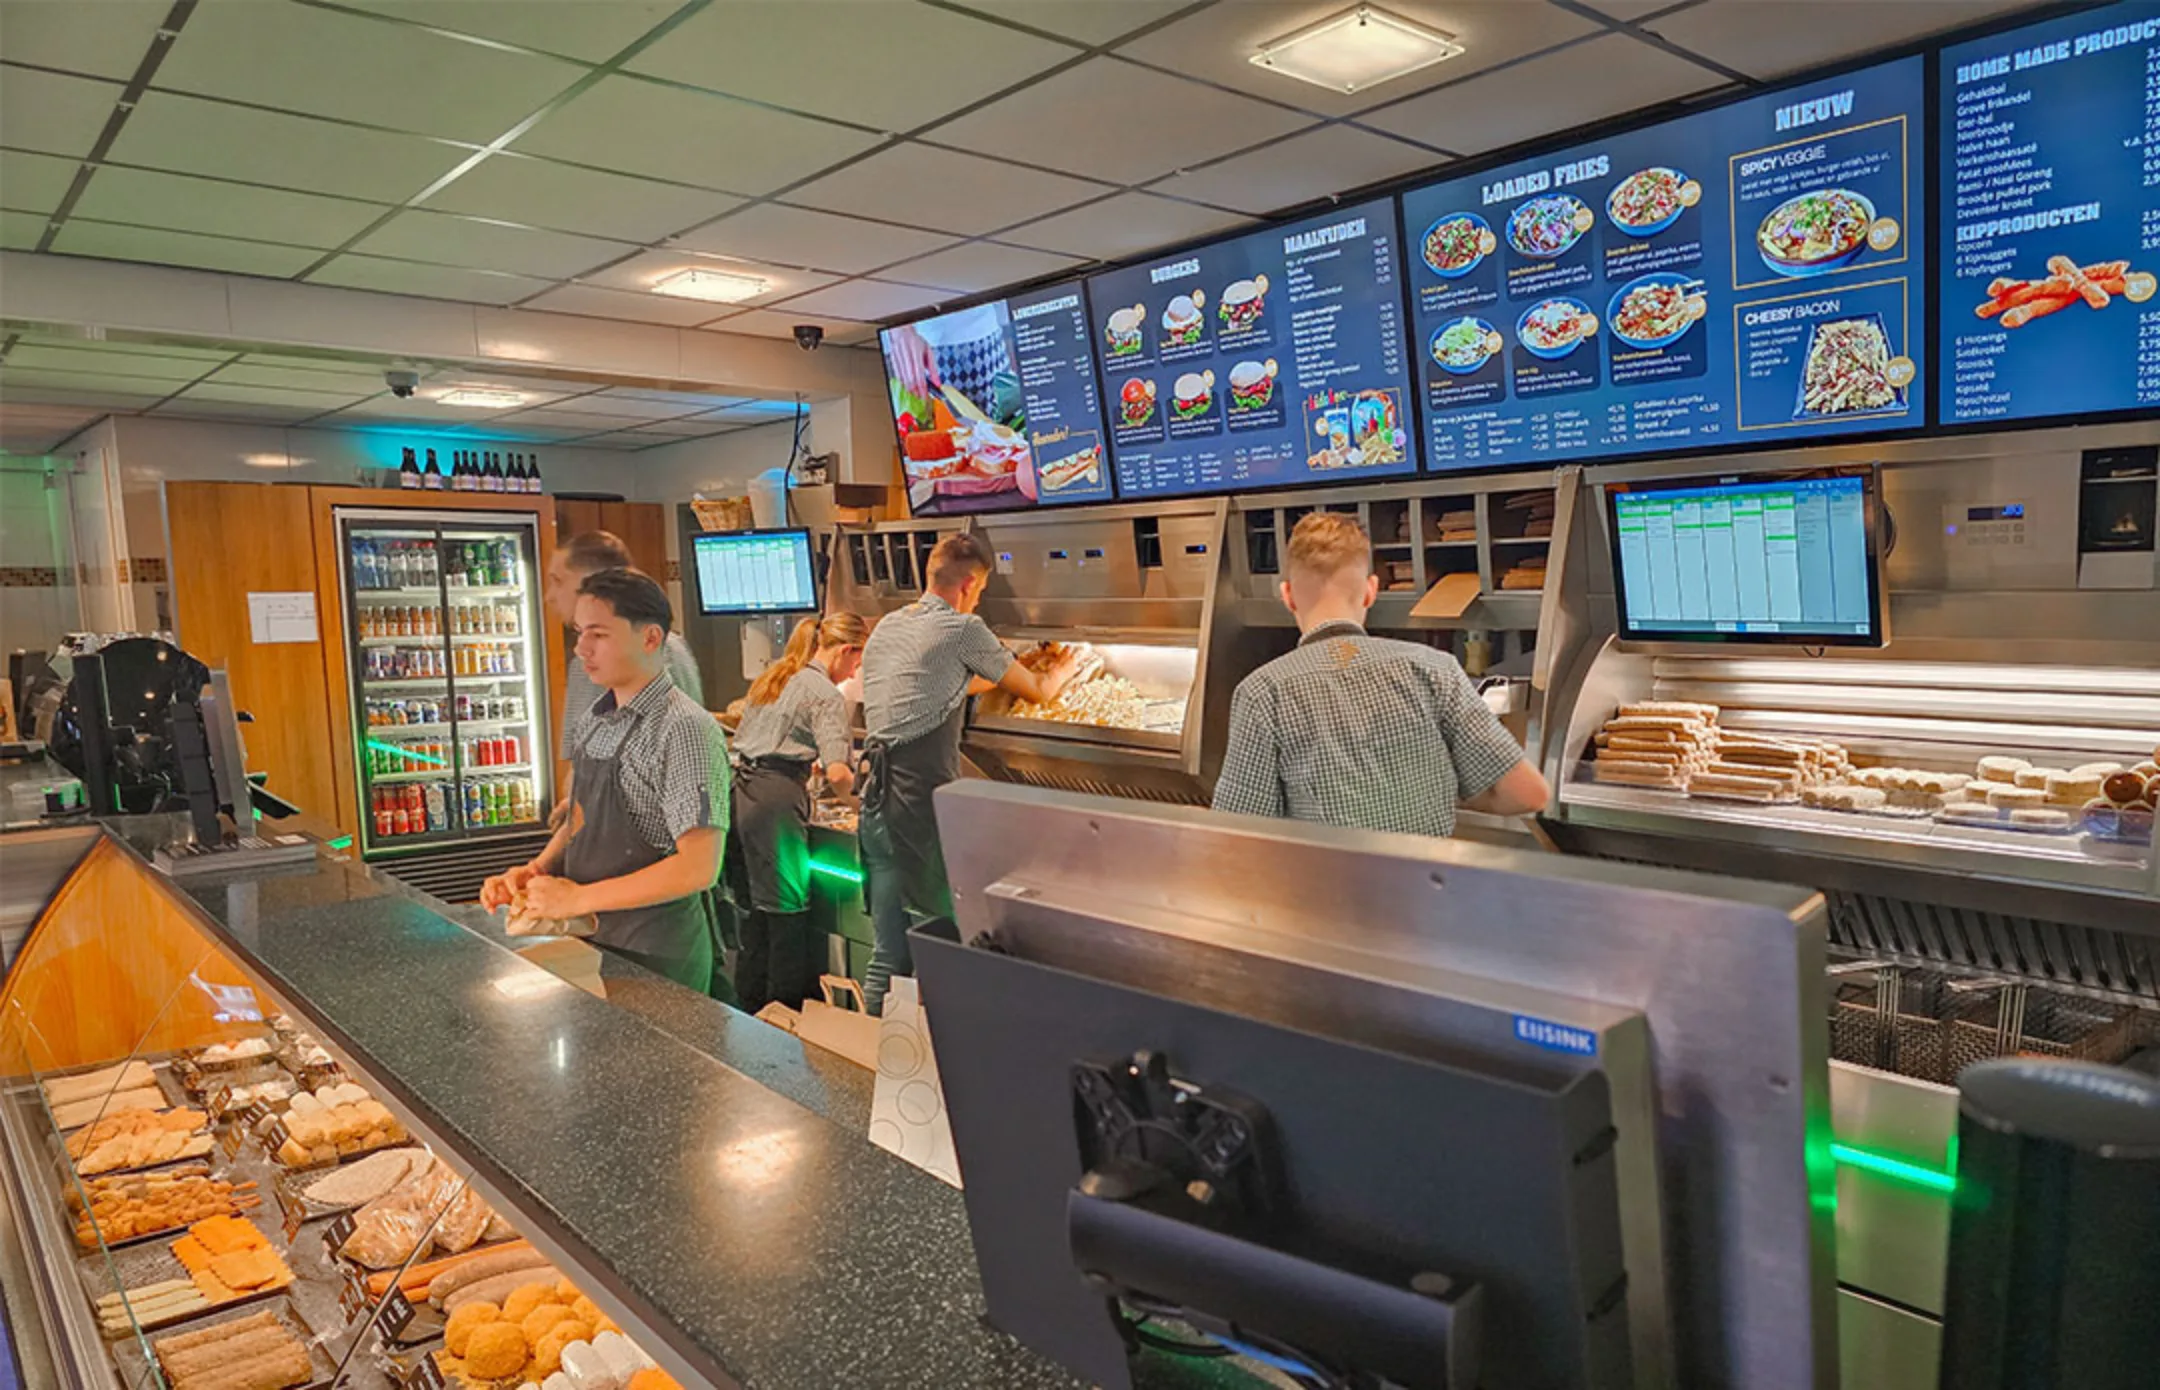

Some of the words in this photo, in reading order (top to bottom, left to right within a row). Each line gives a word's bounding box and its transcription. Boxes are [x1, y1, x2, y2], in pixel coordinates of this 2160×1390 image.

[1956, 56, 2010, 84] HOME
[2014, 41, 2070, 70] MADE
[1956, 82, 2007, 104] Gehaktbal
[1957, 101, 1985, 117] Grove
[1987, 90, 2031, 110] frikandel
[1775, 90, 1854, 132] NIEUW
[1957, 140, 1984, 155] Halve
[1985, 136, 2011, 150] haan
[1741, 156, 1777, 177] SPICY
[1777, 144, 1826, 167] VEGGIE
[1482, 170, 1550, 206] LOADED
[1553, 155, 1610, 187] FRIES
[2016, 167, 2053, 183] Goreng
[1957, 190, 1994, 207] Broodje
[1996, 184, 2026, 202] pulled
[2028, 180, 2052, 196] pork
[1957, 202, 2000, 219] Deventer
[2002, 197, 2033, 212] kroket
[1956, 202, 2101, 242] KIPPRODUCTEN
[1965, 248, 2017, 265] Kipnuggets
[1965, 262, 2012, 279] Kipfingers
[1744, 306, 1794, 326] CHEESY
[1795, 299, 1841, 318] BACON
[1956, 407, 1981, 419] Halve
[1982, 405, 2007, 416] haan
